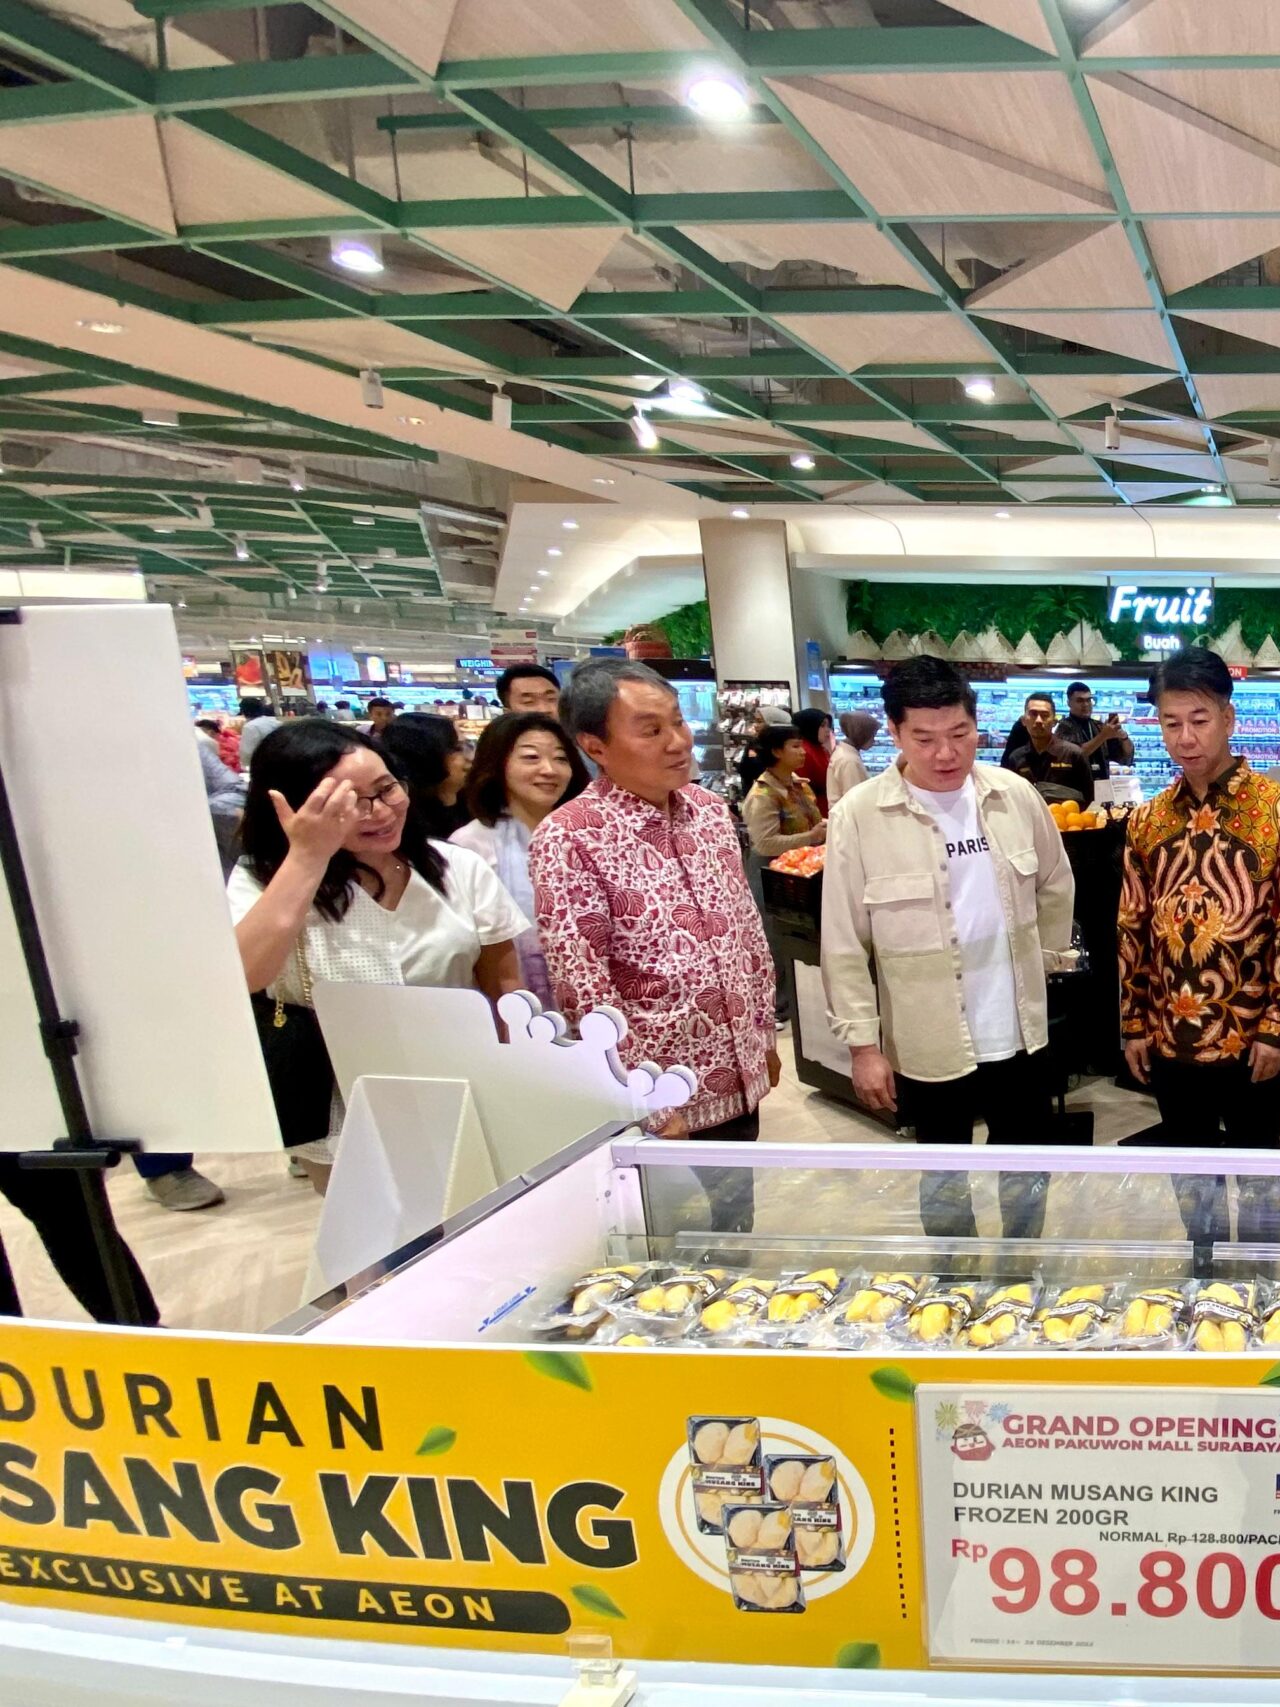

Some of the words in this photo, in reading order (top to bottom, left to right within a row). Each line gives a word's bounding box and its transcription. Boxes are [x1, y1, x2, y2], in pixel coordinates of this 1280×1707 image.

[1110, 585, 1212, 624] Fruit
[1143, 634, 1180, 650] Buah
[460, 659, 495, 668] WEIGHIN
[945, 836, 990, 858] PARIS
[0, 1362, 384, 1451] DURIAN
[1002, 1414, 1119, 1436] GRAND
[1002, 1438, 1050, 1449] AEON
[1054, 1438, 1143, 1451] PAKUWON
[1148, 1440, 1193, 1452] MALL
[953, 1482, 1043, 1500] DURIAN
[1051, 1484, 1154, 1502] MUSANG
[1161, 1486, 1219, 1503] KING
[317, 1472, 639, 1569] KING
[954, 1507, 1048, 1524] FROZEN
[1056, 1508, 1129, 1526] 200GR
[1099, 1531, 1163, 1543] NORMAL
[1168, 1532, 1187, 1545] Rp
[951, 1538, 989, 1563] Rp
[0, 1551, 250, 1603] EXCLUSIVE
[275, 1584, 325, 1611] AT
[357, 1588, 496, 1623] AEON
